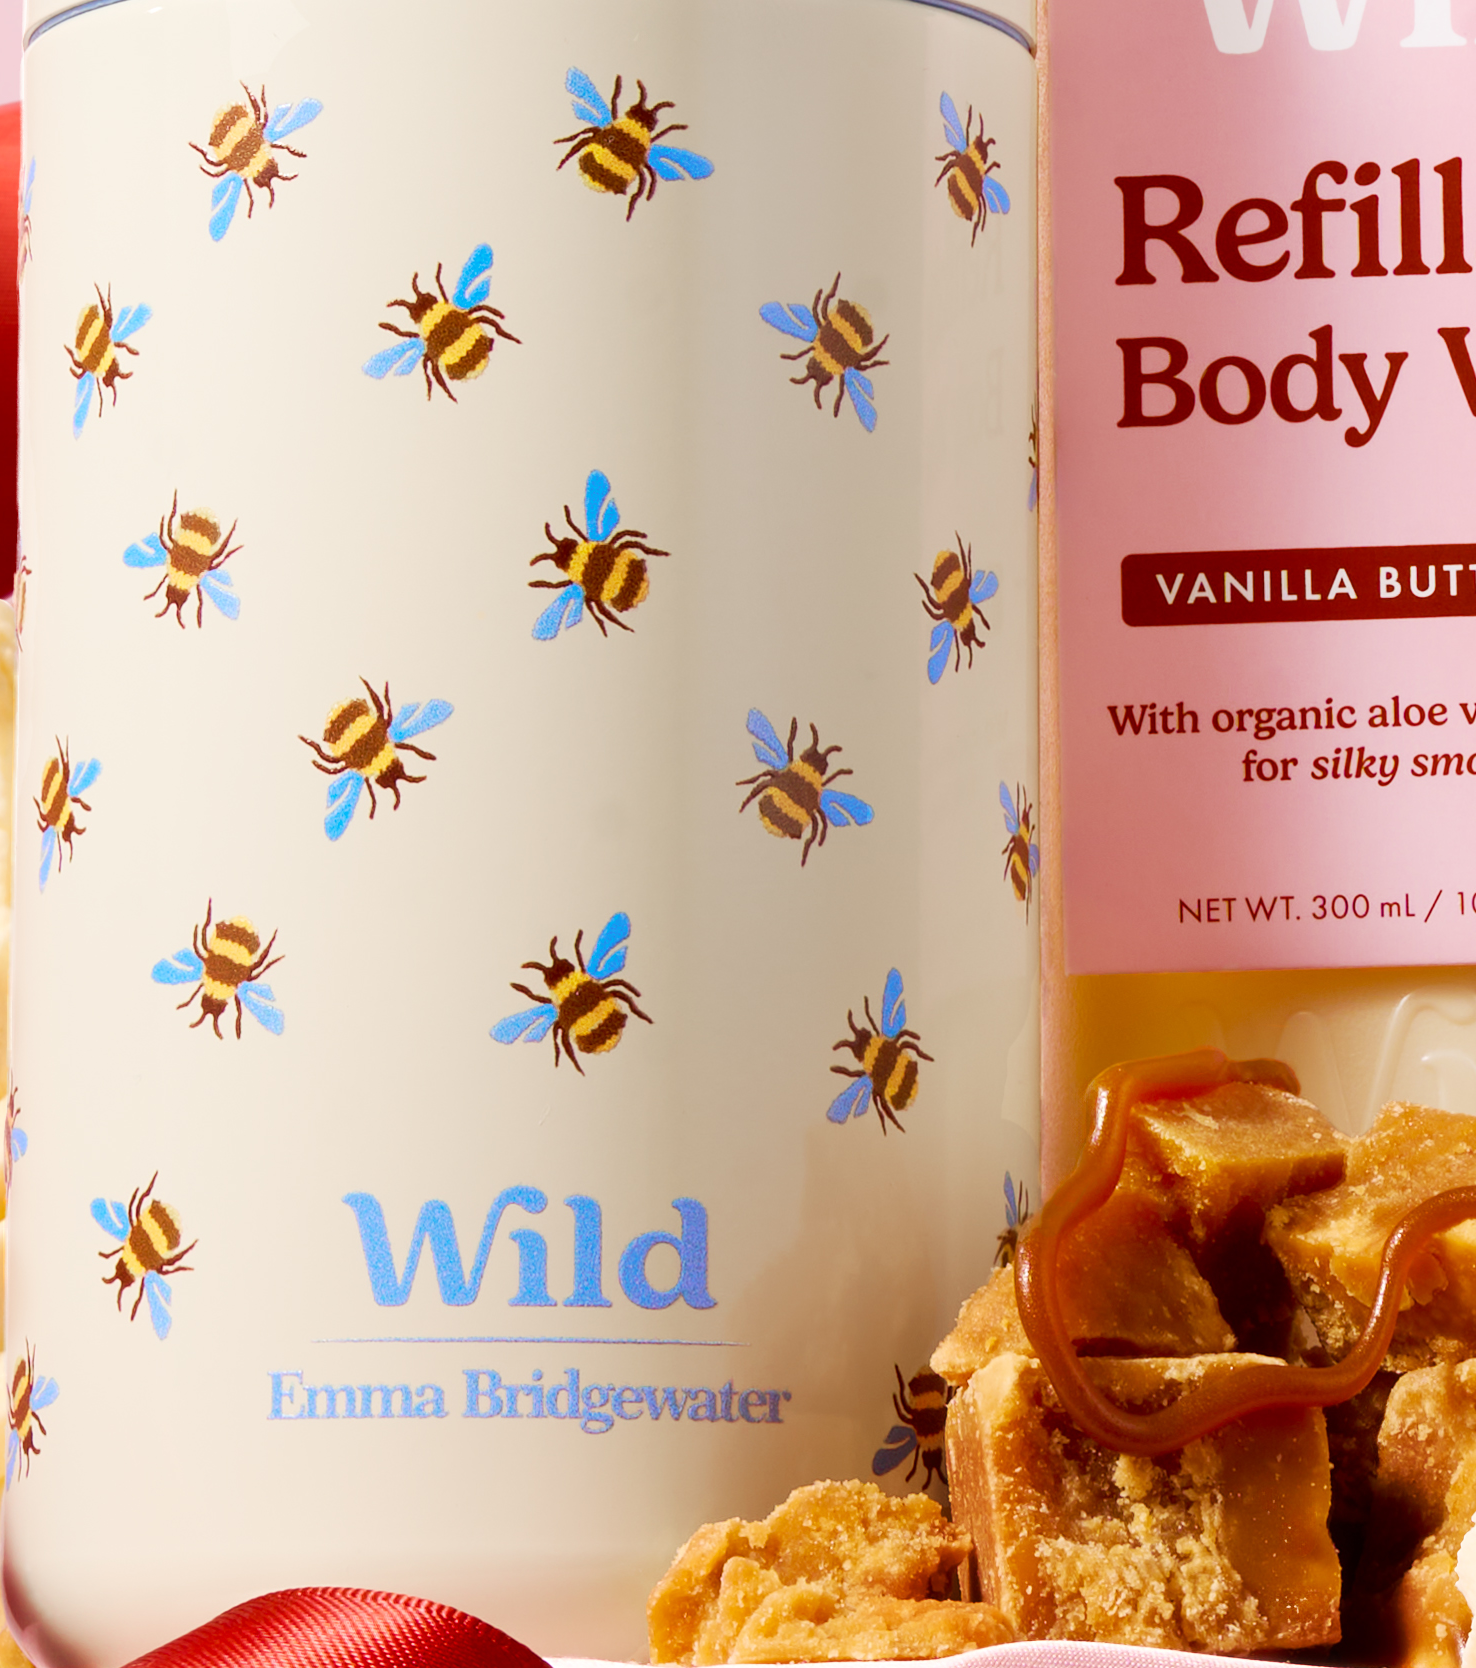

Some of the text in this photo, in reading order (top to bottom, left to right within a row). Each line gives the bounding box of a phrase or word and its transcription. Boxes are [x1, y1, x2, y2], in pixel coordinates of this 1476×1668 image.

[1115, 323, 1409, 449] Body
[1155, 566, 1358, 607] VANILLA
[1106, 700, 1202, 737] With
[1211, 697, 1357, 741] organic
[1367, 695, 1448, 728] aloe
[1241, 750, 1299, 783] for
[1310, 746, 1400, 787] silky
[1178, 897, 1236, 925] NET
[1246, 895, 1301, 923] WT.
[1311, 893, 1370, 921] 300
[1380, 893, 1416, 918] mL
[341, 1184, 718, 1310] Wild
[267, 1367, 792, 1435] Emma Bridgewater
